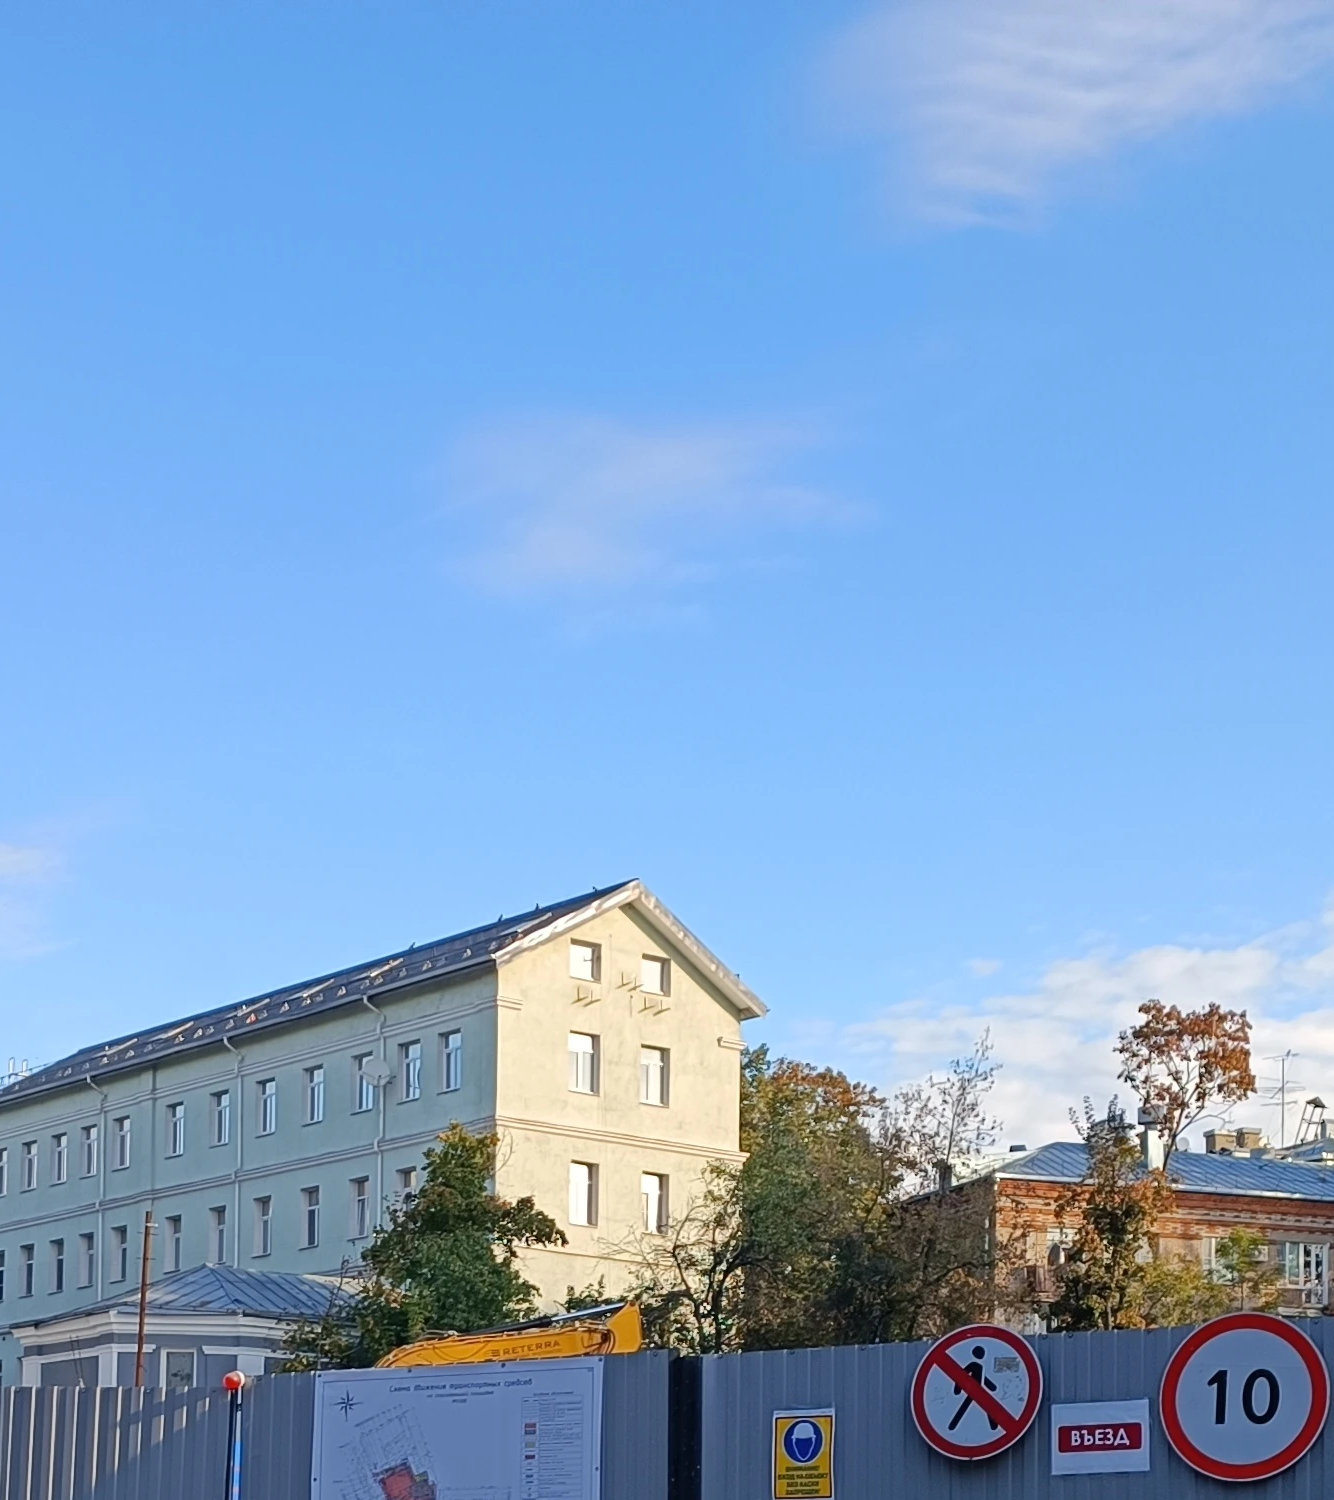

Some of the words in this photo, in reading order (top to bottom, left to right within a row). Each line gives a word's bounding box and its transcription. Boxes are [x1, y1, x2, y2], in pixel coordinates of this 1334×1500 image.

[502, 1339, 561, 1356] RETERRA
[1207, 1369, 1280, 1425] 10
[1071, 1428, 1130, 1446] ВЪЕЗД
